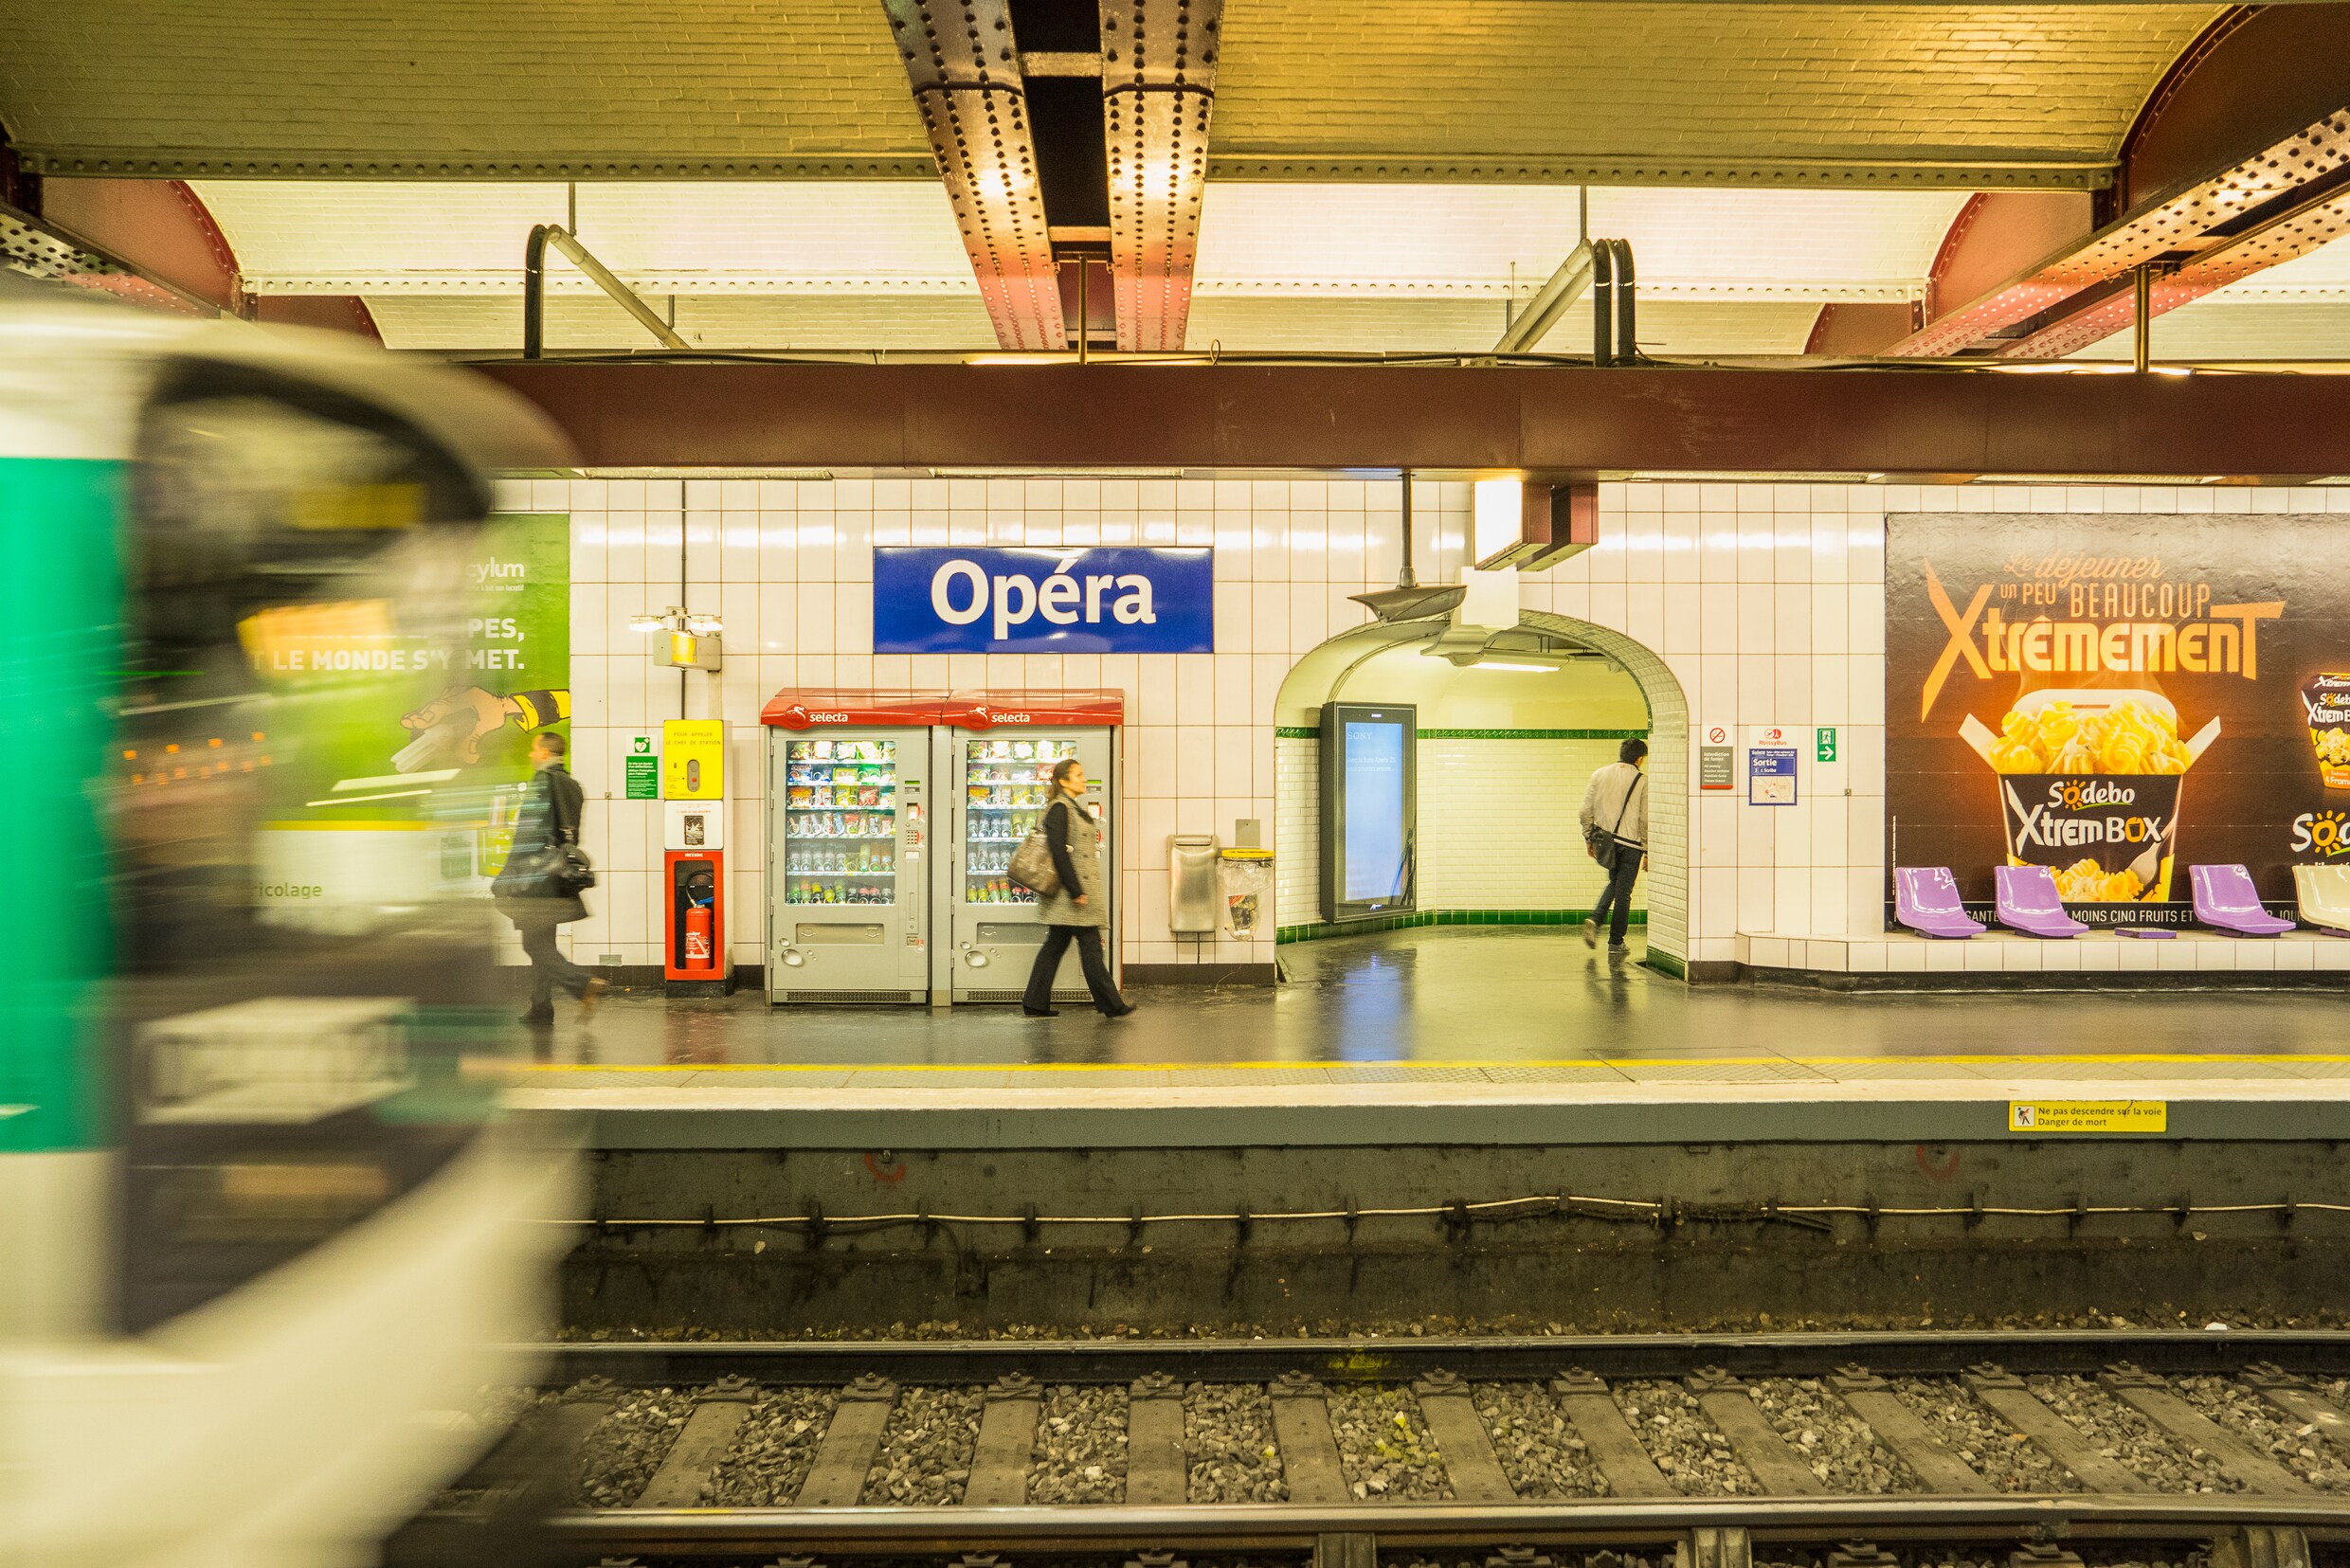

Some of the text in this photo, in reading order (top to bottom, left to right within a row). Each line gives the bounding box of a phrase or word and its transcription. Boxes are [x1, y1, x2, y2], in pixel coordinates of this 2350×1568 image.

[467, 556, 524, 584] cylum
[931, 558, 1157, 640] Opéra
[2022, 583, 2056, 604] PEU
[2070, 583, 2211, 618] BEAUCOUP
[468, 618, 524, 642] PES,
[272, 650, 304, 670] LE
[312, 650, 407, 670] MONDE
[464, 649, 524, 669] MET.
[2319, 693, 2350, 707] Sodeb
[809, 712, 848, 723] selecta
[991, 712, 1030, 723] selecta
[1347, 731, 1373, 740] SONY
[1753, 758, 1778, 766] Sortie
[2048, 780, 2136, 811] Sodebo
[259, 882, 322, 899] icolage
[2071, 910, 2107, 922] MOINS
[2110, 910, 2136, 922] CINQ
[2140, 910, 2178, 922] FRUITS
[2181, 910, 2194, 922] ET
[2038, 1107, 2051, 1115] Ne
[2070, 1107, 2115, 1115] descendre
[2133, 1107, 2142, 1115] la
[2038, 1118, 2070, 1127] Danger
[2071, 1118, 2083, 1126] de
